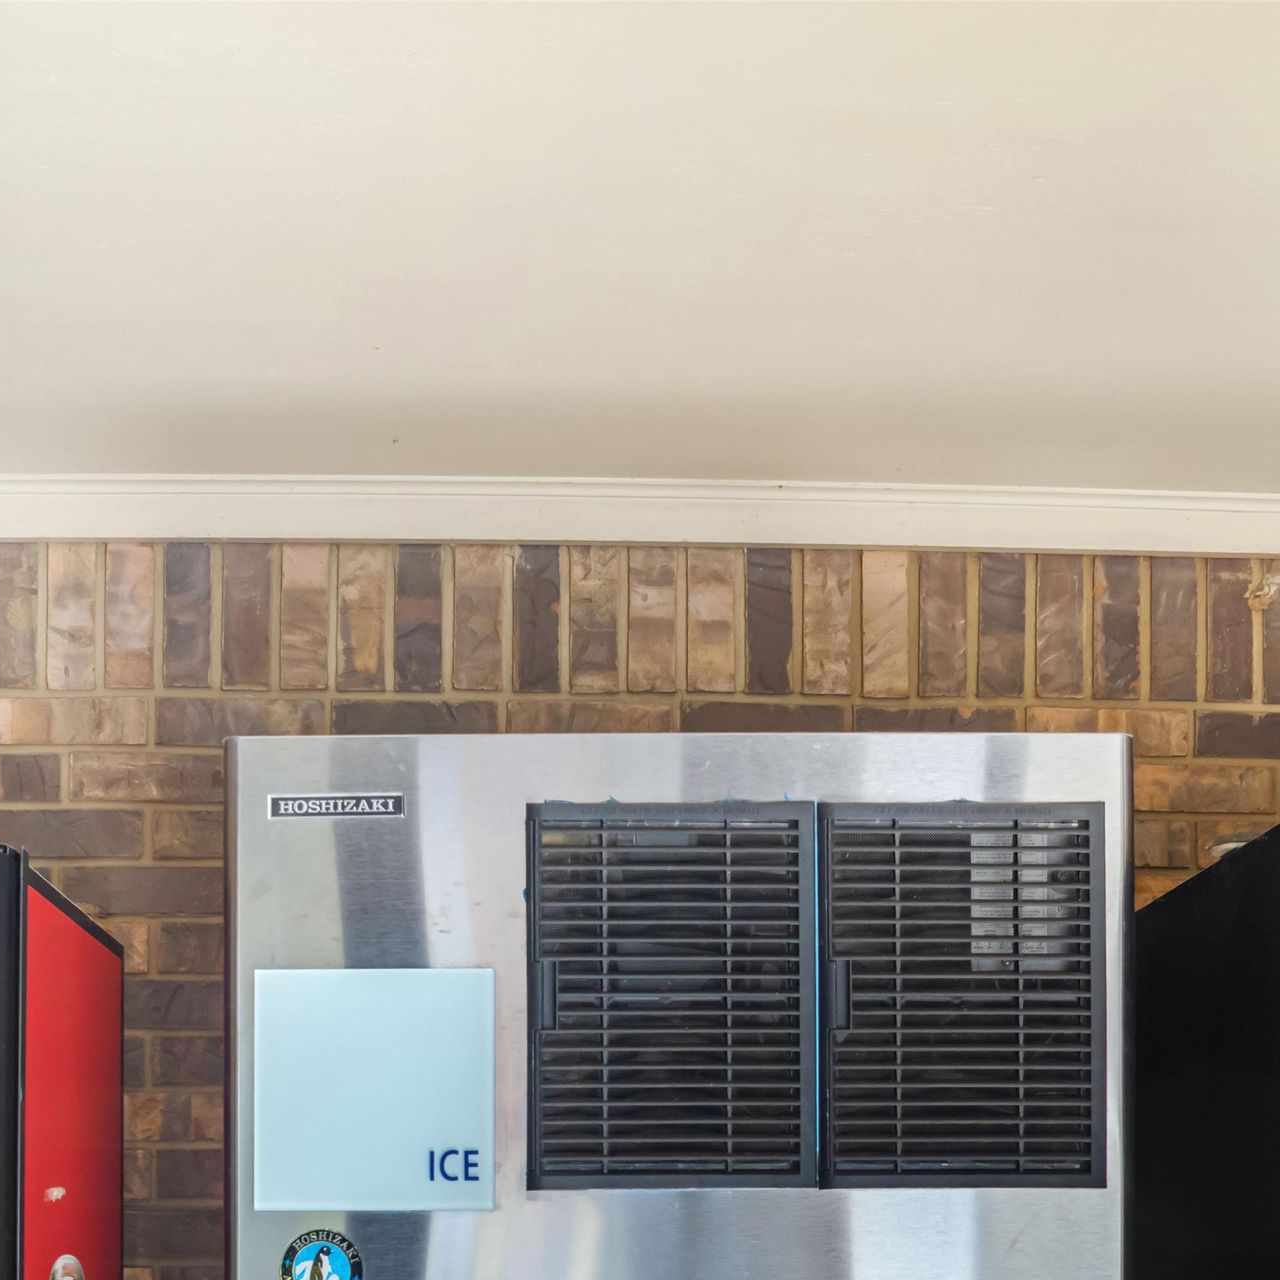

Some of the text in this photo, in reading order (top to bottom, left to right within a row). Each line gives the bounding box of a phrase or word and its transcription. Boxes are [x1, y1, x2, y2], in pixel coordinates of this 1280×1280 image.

[278, 799, 395, 814] HOSHIZAKI
[429, 1149, 480, 1182] ICE
[292, 1231, 360, 1263] HOSHIZAKI
